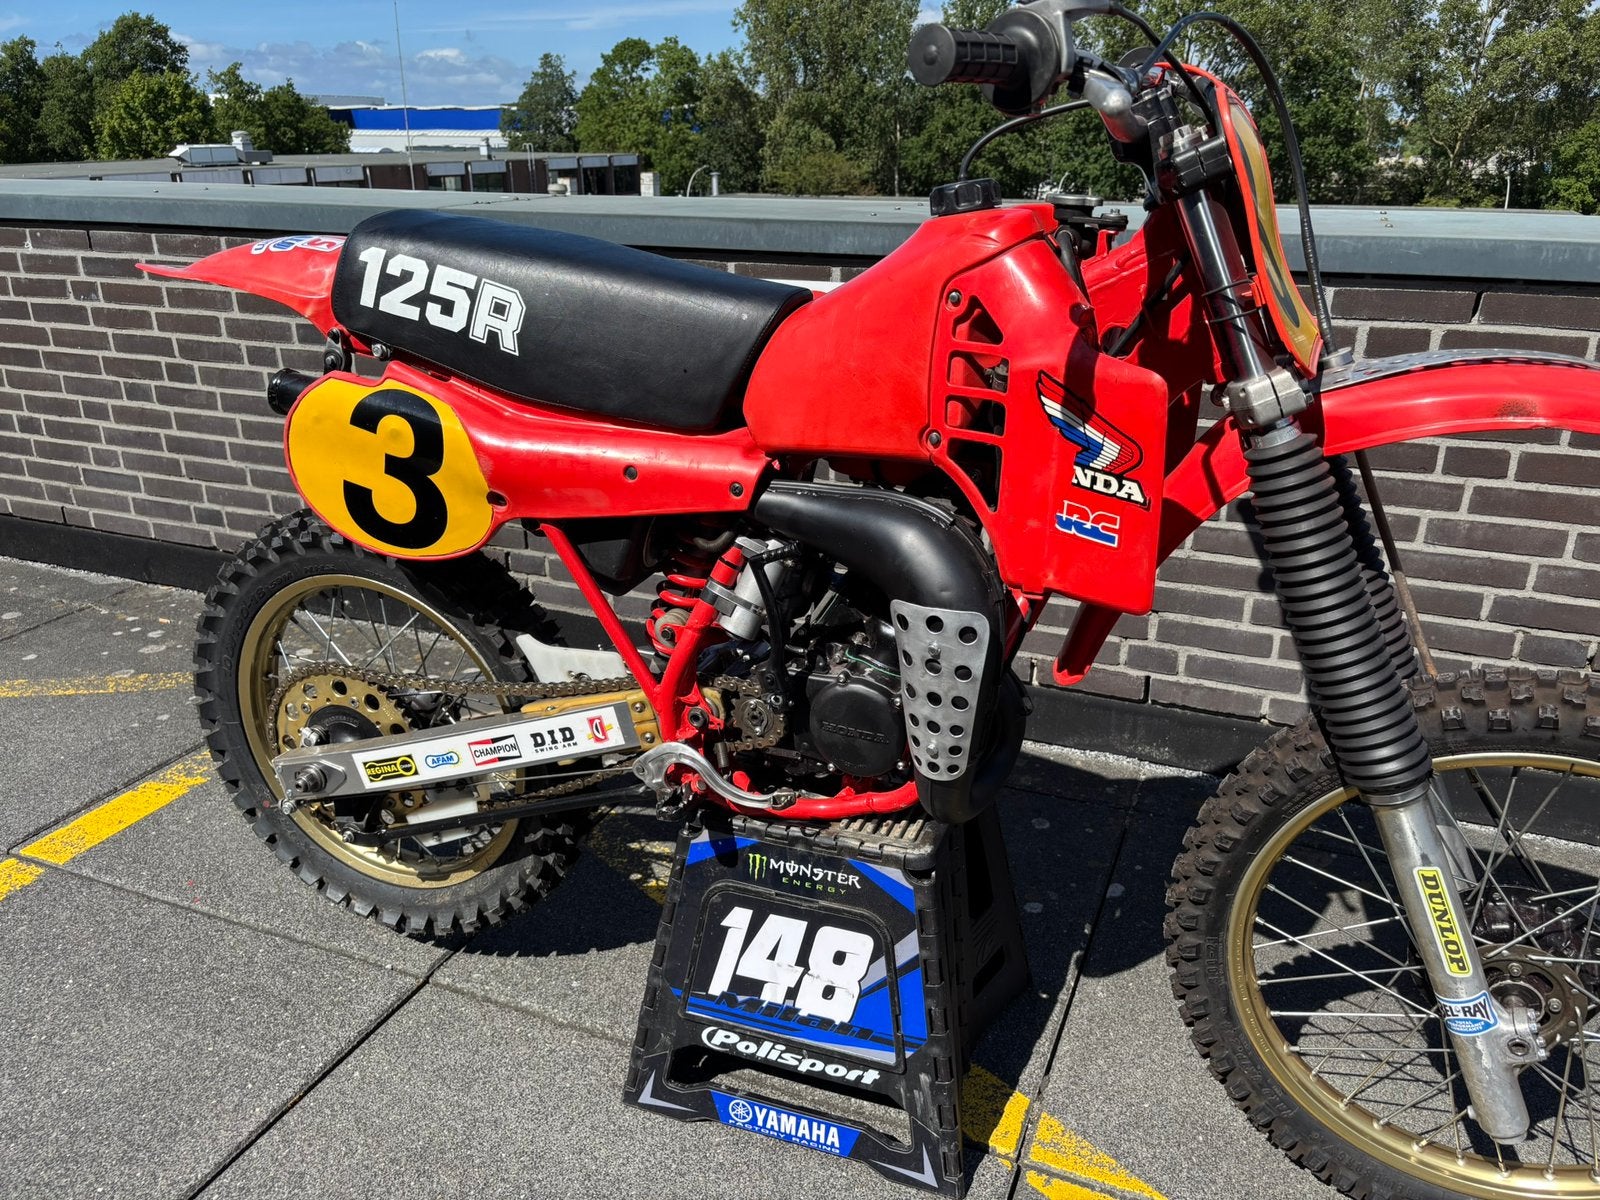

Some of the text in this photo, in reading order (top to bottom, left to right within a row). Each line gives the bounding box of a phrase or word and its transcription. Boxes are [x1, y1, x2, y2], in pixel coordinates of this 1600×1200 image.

[358, 246, 527, 356] 125R
[343, 388, 448, 549] 3
[534, 741, 578, 753] SWING ARM
[821, 720, 890, 745] HONDA
[431, 754, 455, 765] AFAM
[473, 742, 517, 759] CHAMPION
[366, 764, 398, 776] REGINA
[782, 876, 847, 895] ENERGY
[1420, 873, 1467, 974] DUNLOP
[707, 906, 874, 1025] 148
[707, 1027, 881, 1085] Polisport
[728, 1119, 840, 1154] FACTORY RACING
[753, 1105, 840, 1148] YAMAHA
